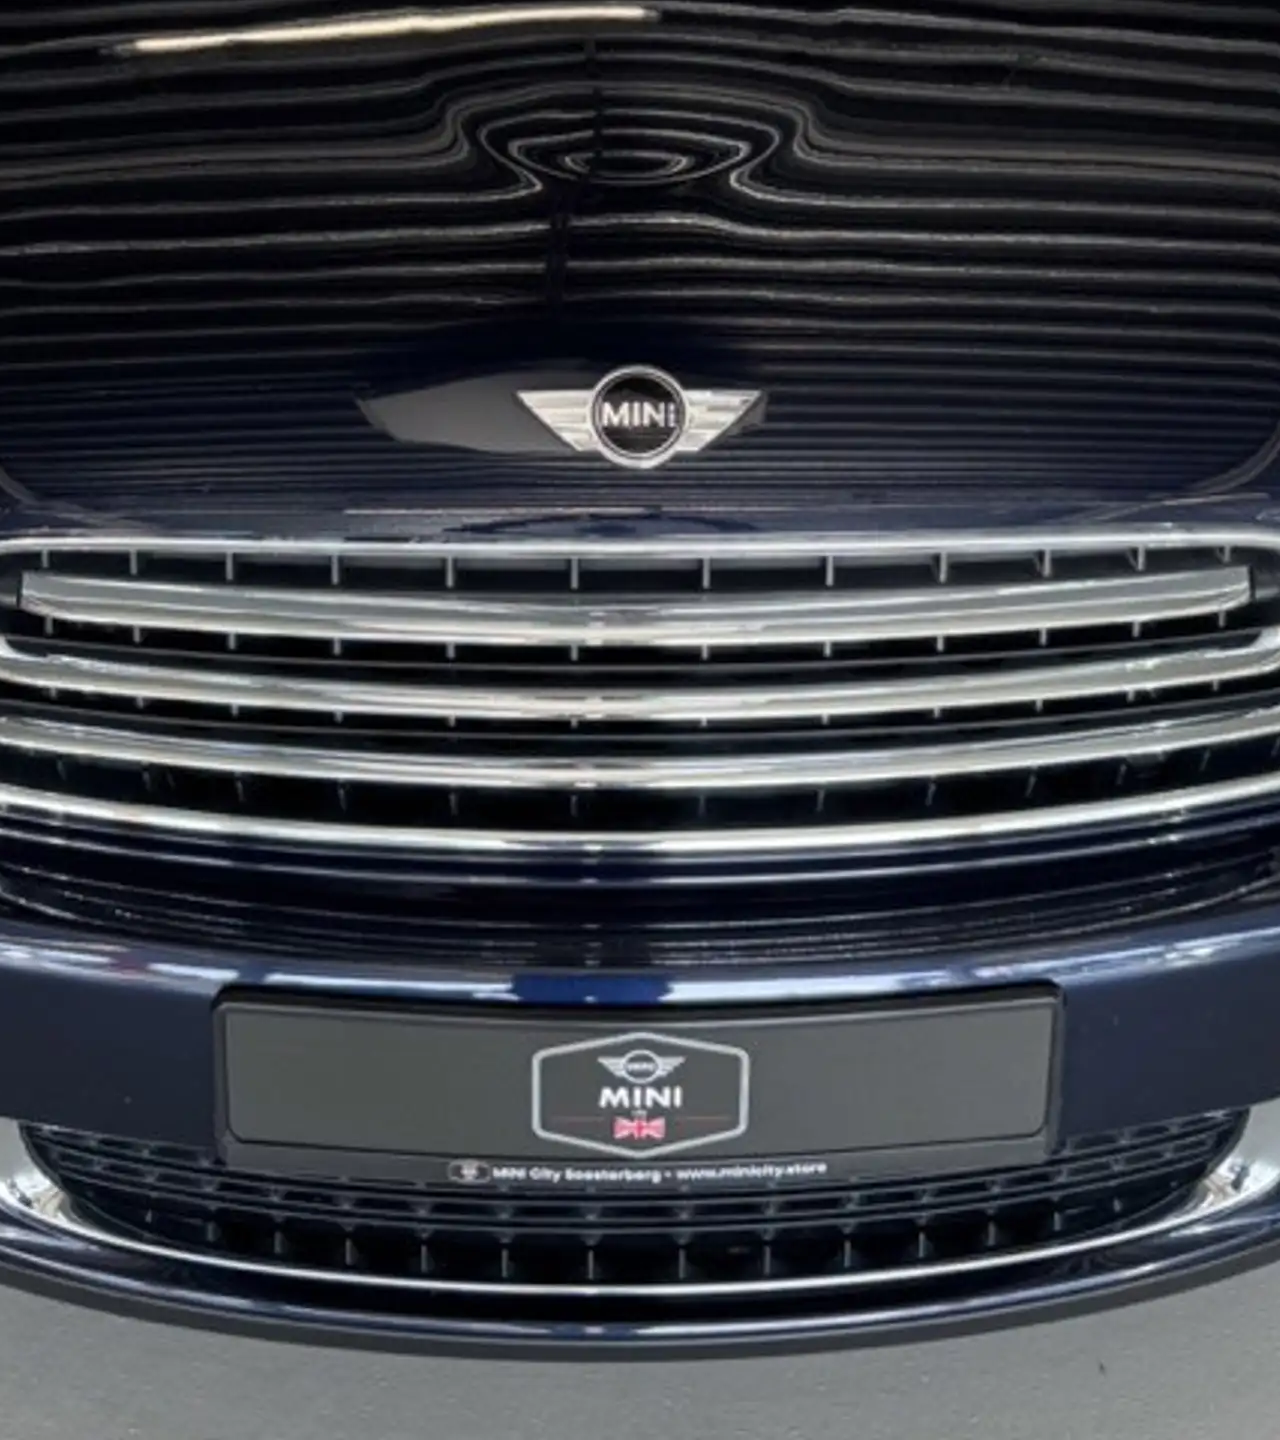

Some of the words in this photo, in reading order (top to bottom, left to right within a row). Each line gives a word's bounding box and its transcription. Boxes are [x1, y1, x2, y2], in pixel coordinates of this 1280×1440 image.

[602, 401, 676, 428] MINI
[598, 1085, 683, 1108] MINI
[529, 1166, 561, 1183] City
